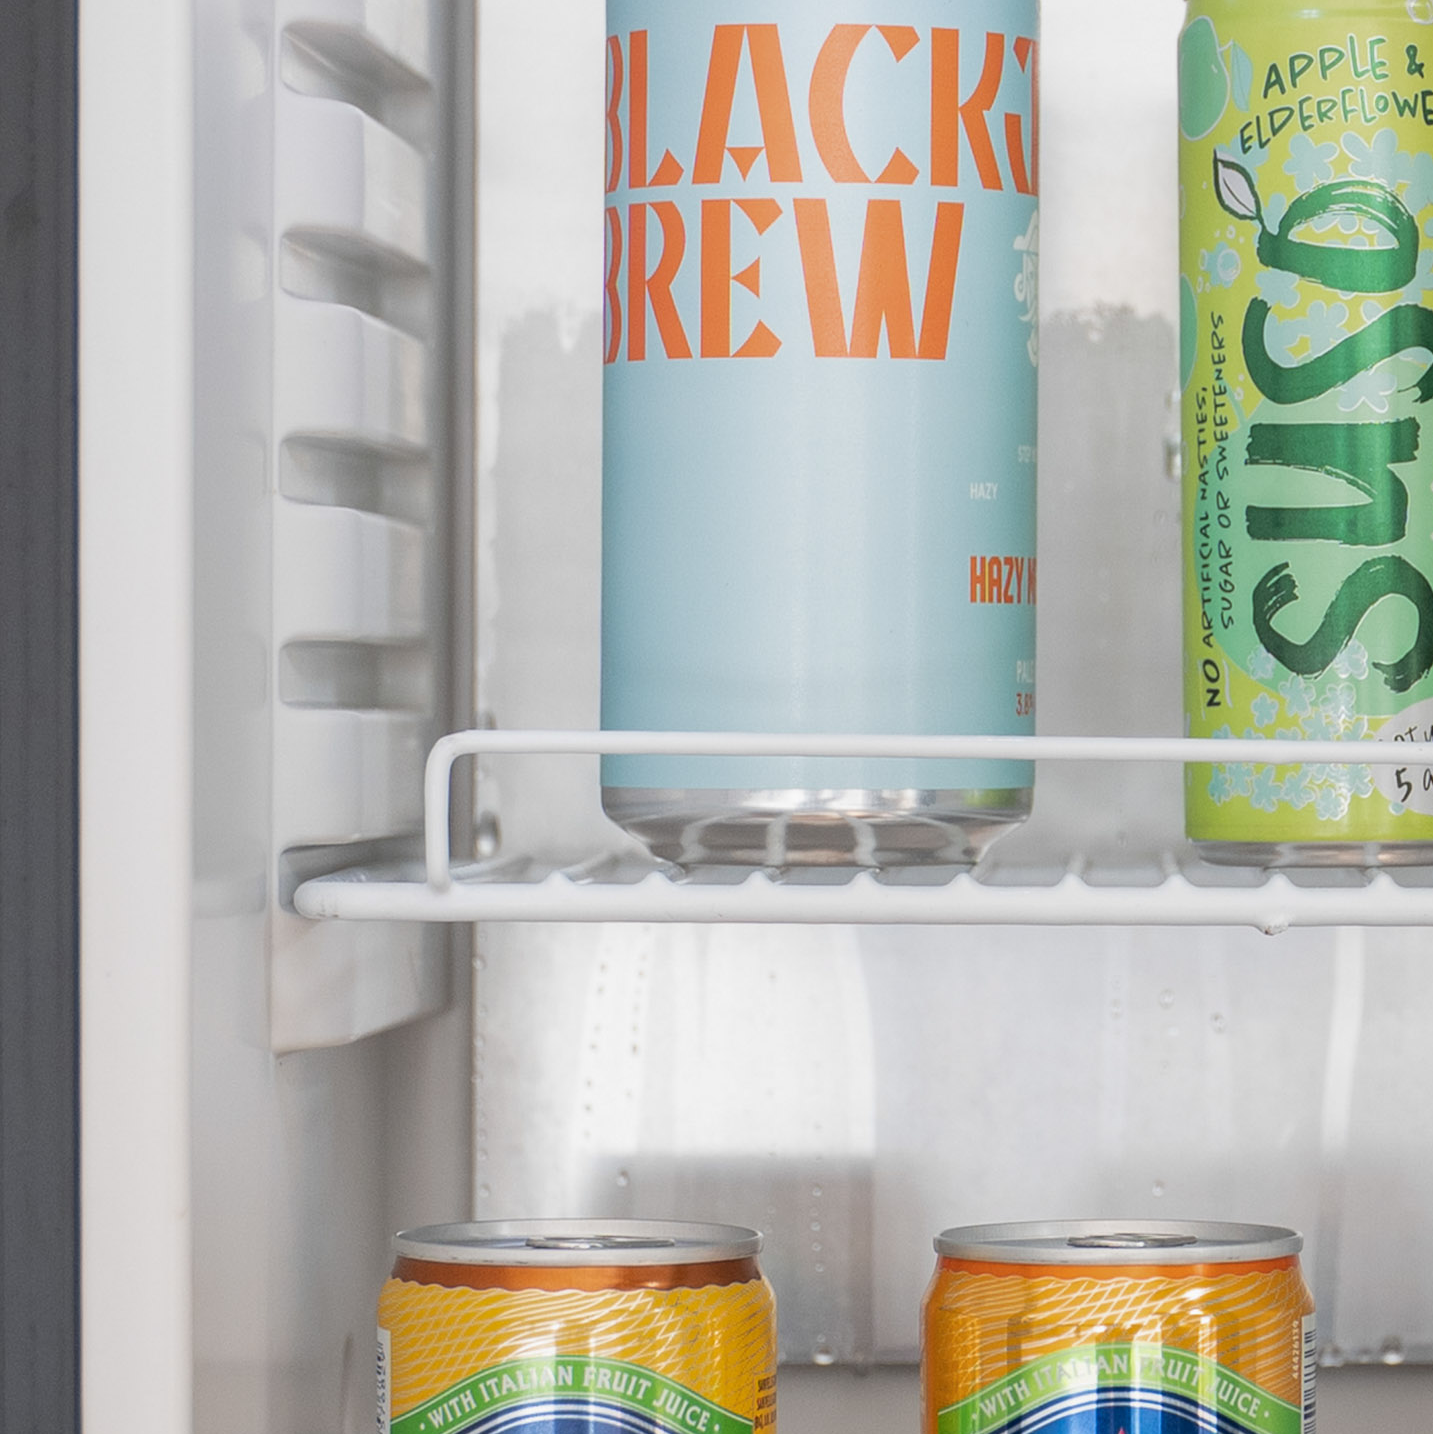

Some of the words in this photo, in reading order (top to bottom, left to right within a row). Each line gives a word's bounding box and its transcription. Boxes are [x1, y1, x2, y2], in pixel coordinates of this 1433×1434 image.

[1262, 35, 1390, 99] APPLE
[1405, 44, 1425, 78] &
[1210, 311, 1230, 481] SWEETENERS
[1195, 386, 1209, 502] NASTIES,
[969, 482, 998, 500] HAZY
[1215, 491, 1232, 530] OR
[970, 555, 1024, 604] HAZY
[1199, 510, 1214, 648] ARTIFICIAL
[1216, 542, 1234, 630] SUGAR
[1203, 658, 1221, 708] NO
[1394, 767, 1413, 803] 5
[427, 1390, 478, 1430] WITH
[479, 1365, 573, 1405] ITALIAN
[583, 1365, 652, 1400] FRUIT
[652, 1388, 711, 1432] JUICE
[978, 1379, 1029, 1419] WITH
[1035, 1353, 1128, 1389] ITALIAN
[1139, 1354, 1205, 1388] FRUIT
[1206, 1377, 1261, 1419] JUICE
